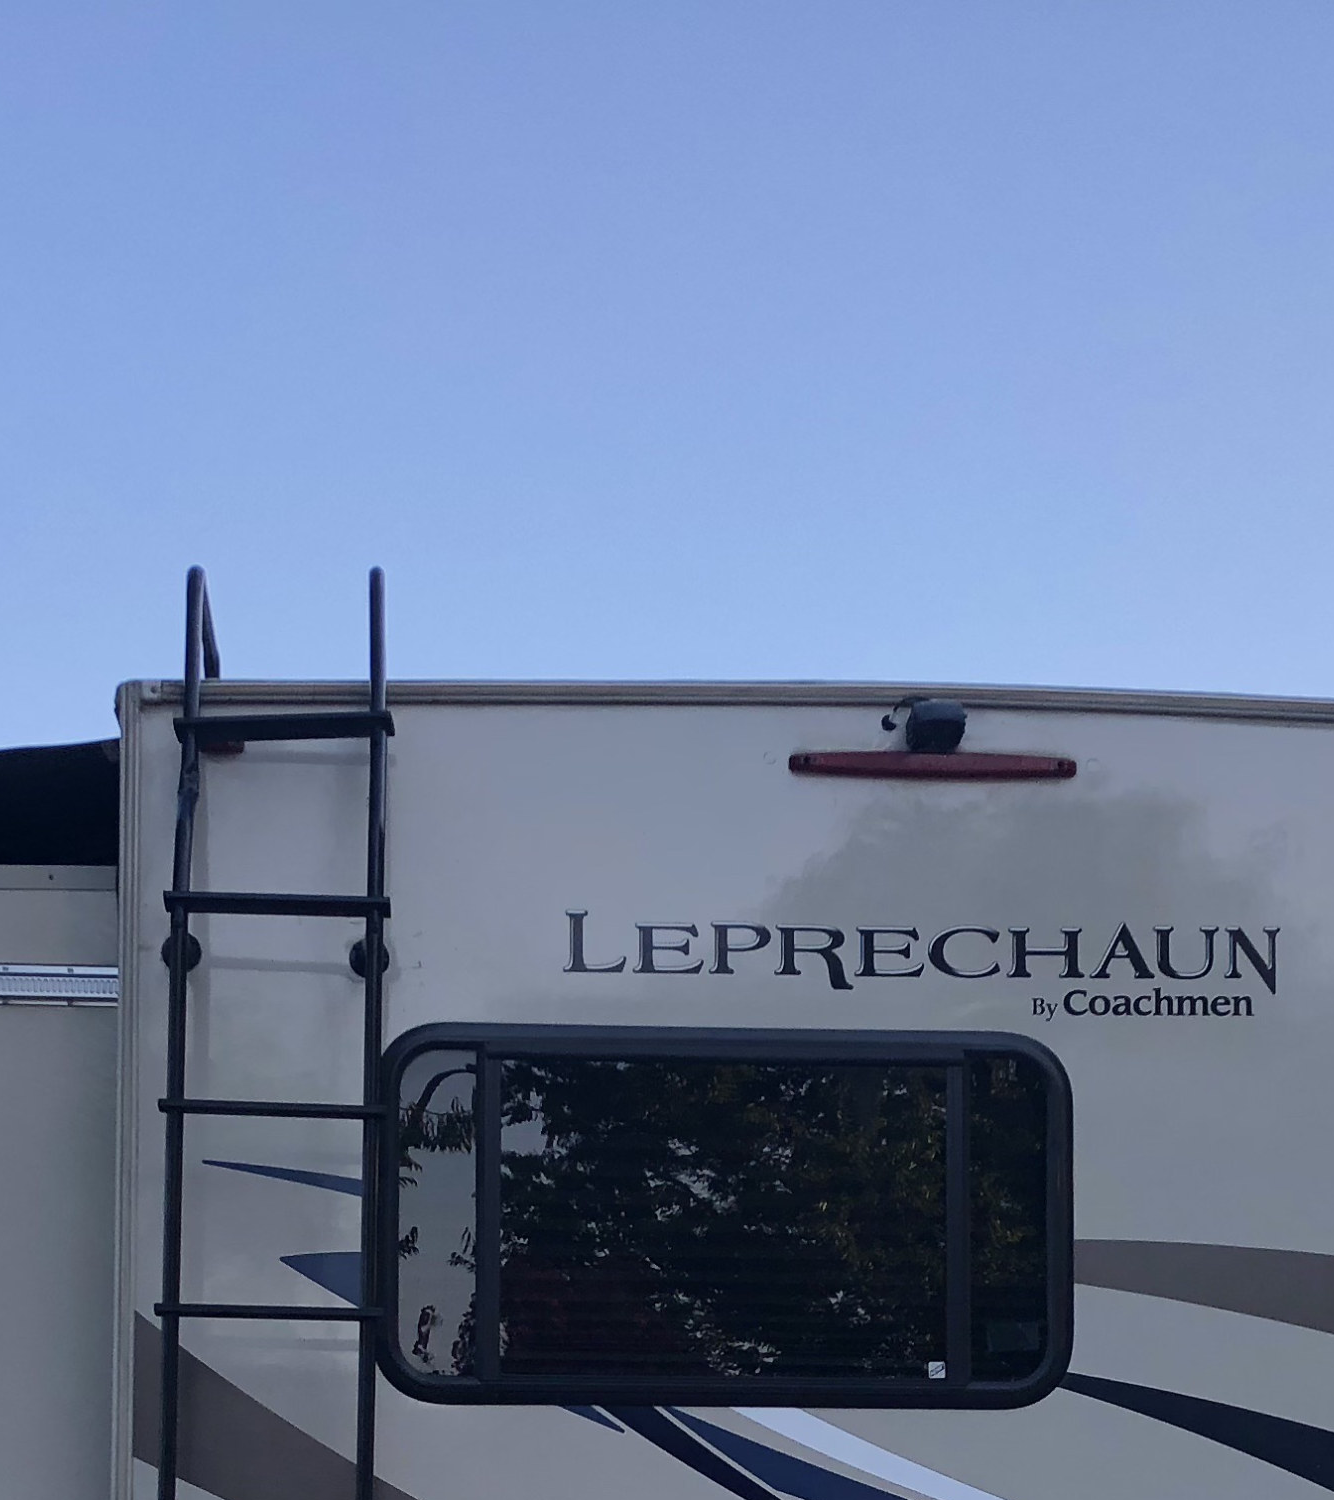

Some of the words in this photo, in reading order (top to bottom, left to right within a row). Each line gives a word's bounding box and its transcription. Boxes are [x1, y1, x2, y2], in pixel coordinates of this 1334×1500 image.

[563, 908, 1281, 995] LEPRECHAUN
[1031, 996, 1058, 1020] By
[1062, 986, 1255, 1018] Coachmen
